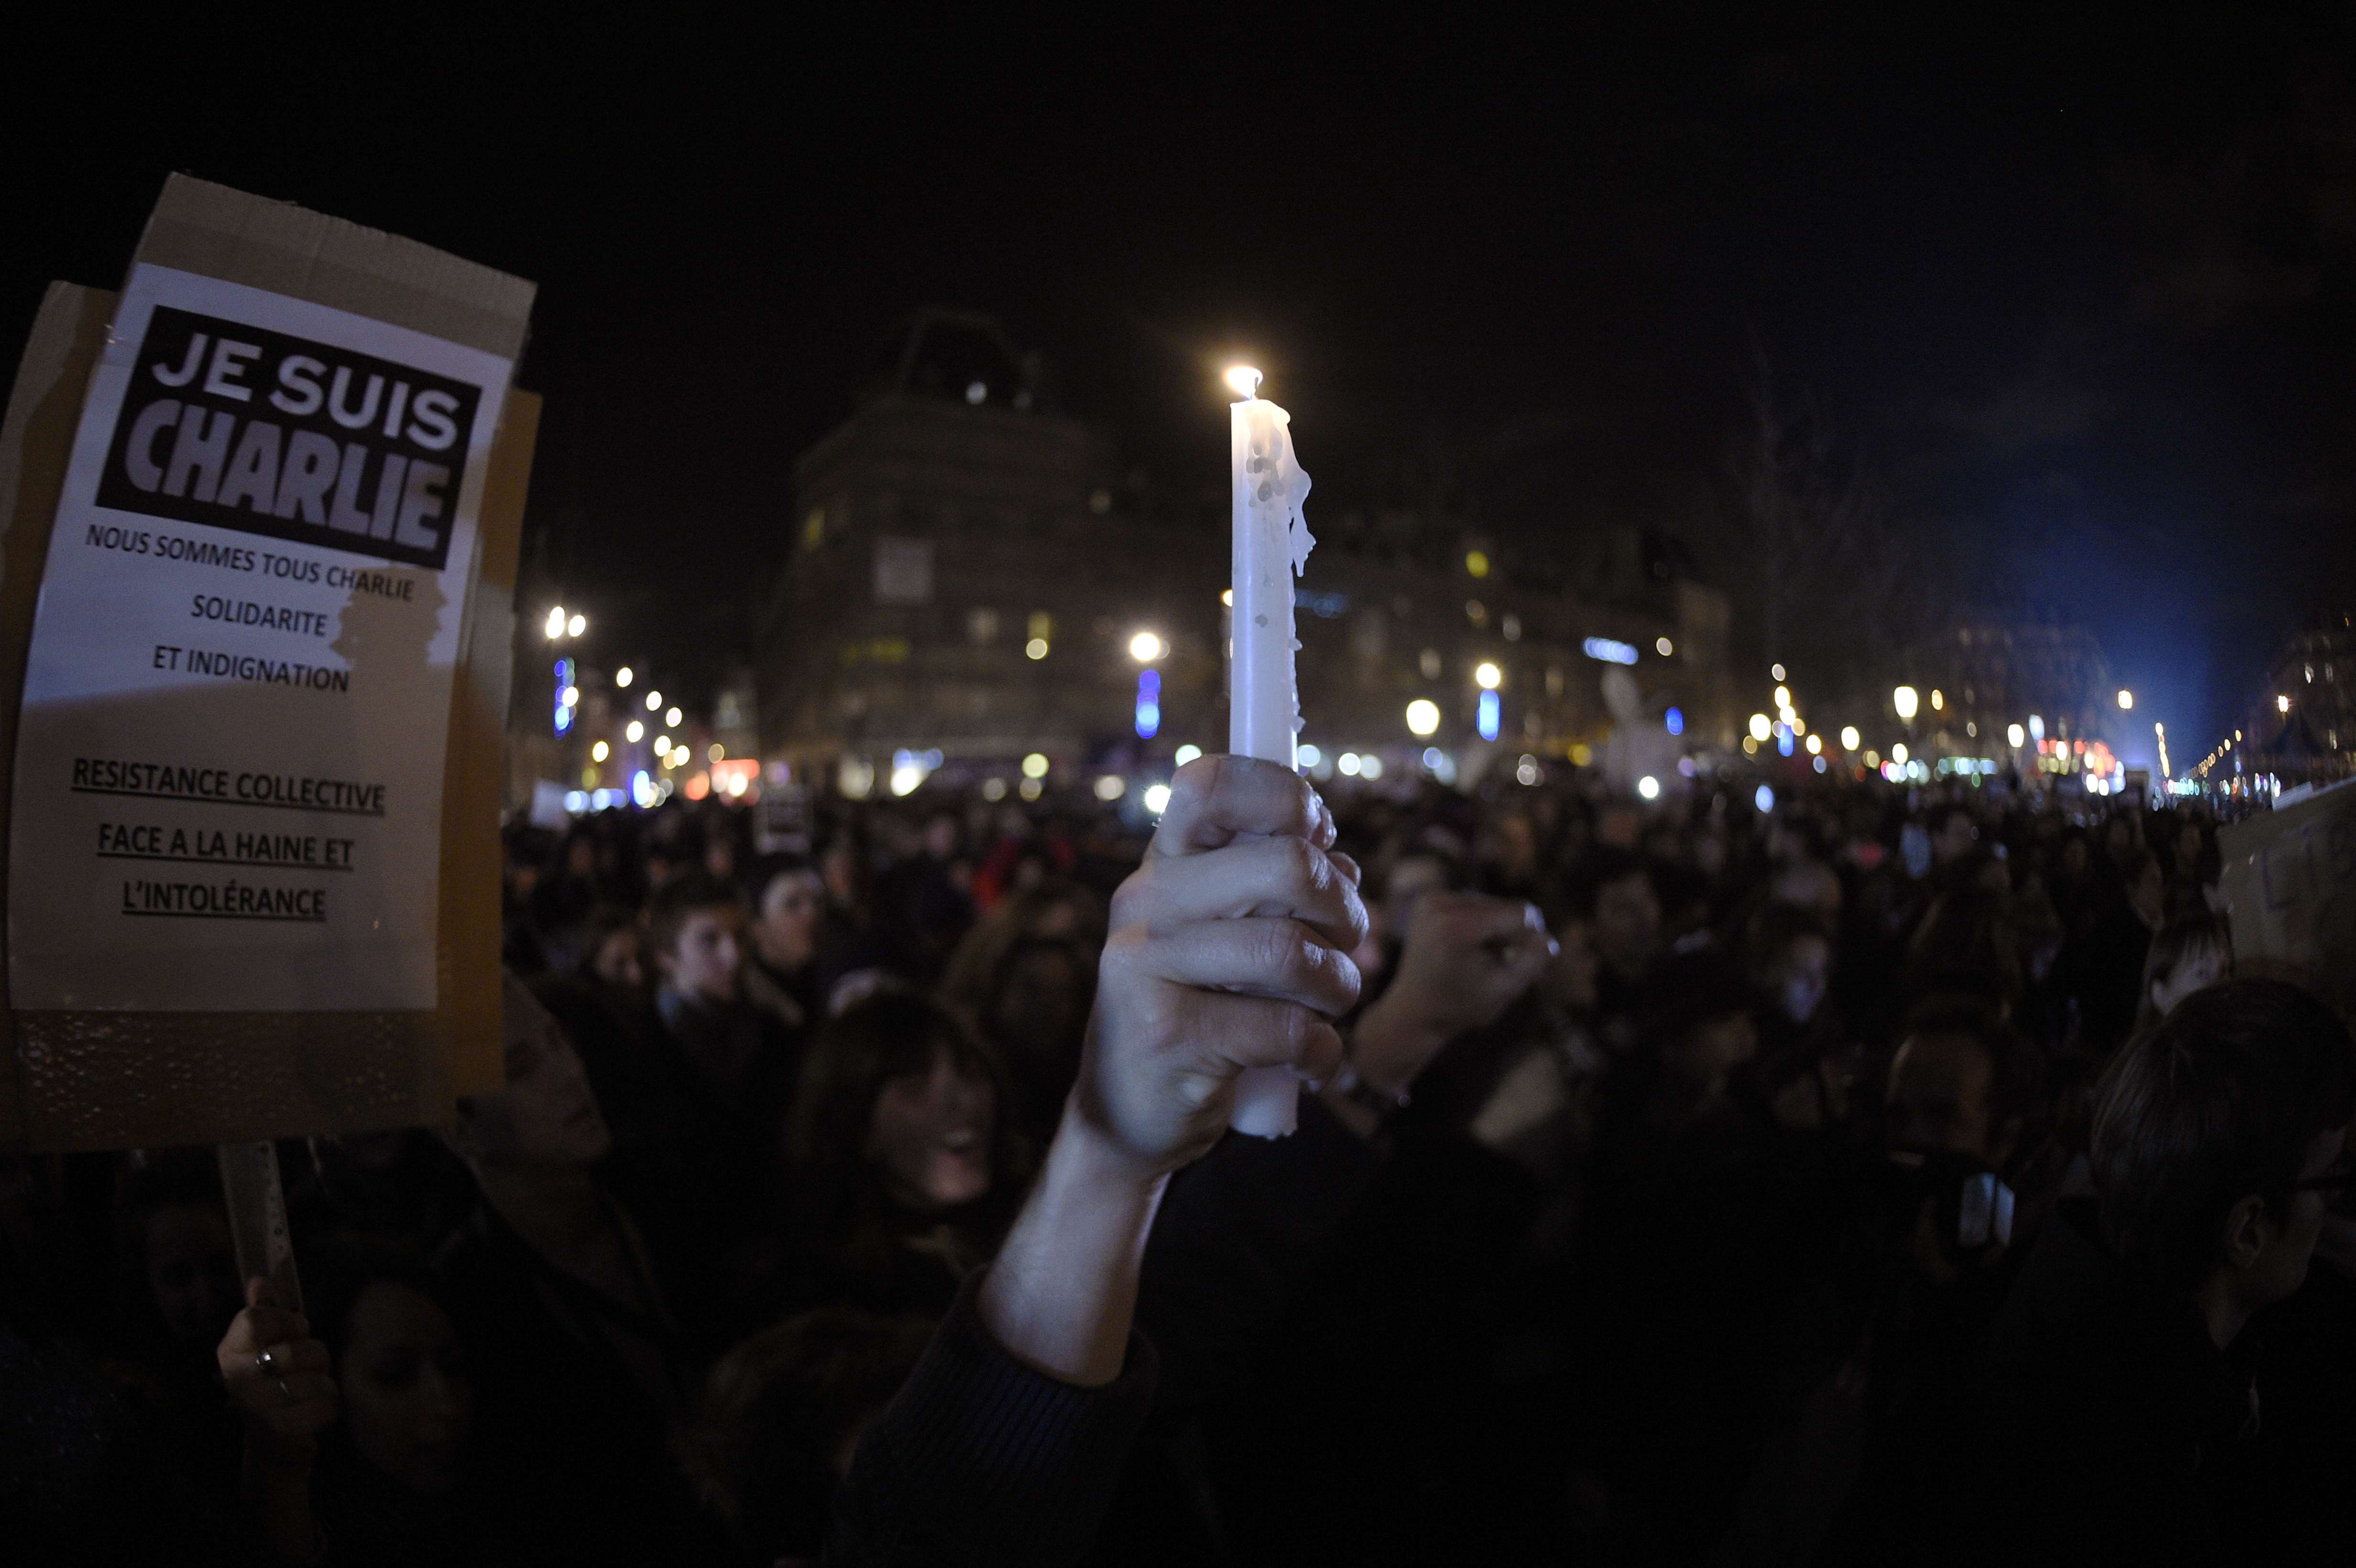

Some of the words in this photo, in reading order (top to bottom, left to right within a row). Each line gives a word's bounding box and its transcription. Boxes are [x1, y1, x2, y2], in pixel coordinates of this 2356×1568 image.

[151, 333, 262, 402] JE
[268, 355, 460, 451] SUIS
[125, 399, 451, 551] CHARLIE
[86, 524, 149, 554] NOUS
[154, 536, 255, 572] SOMMES
[263, 553, 320, 584] TOUS
[326, 566, 415, 602] CHARLIE
[191, 595, 327, 637] SOLIDARITE
[153, 646, 181, 670] ET
[187, 650, 349, 693] INDIGNATION
[73, 758, 229, 797] RESISTANCE
[237, 773, 386, 809] COLLECTIVE
[98, 824, 162, 852] FACE
[170, 828, 187, 855] A
[197, 831, 226, 857] LA
[236, 833, 316, 862] HAINE
[325, 839, 354, 864] ET
